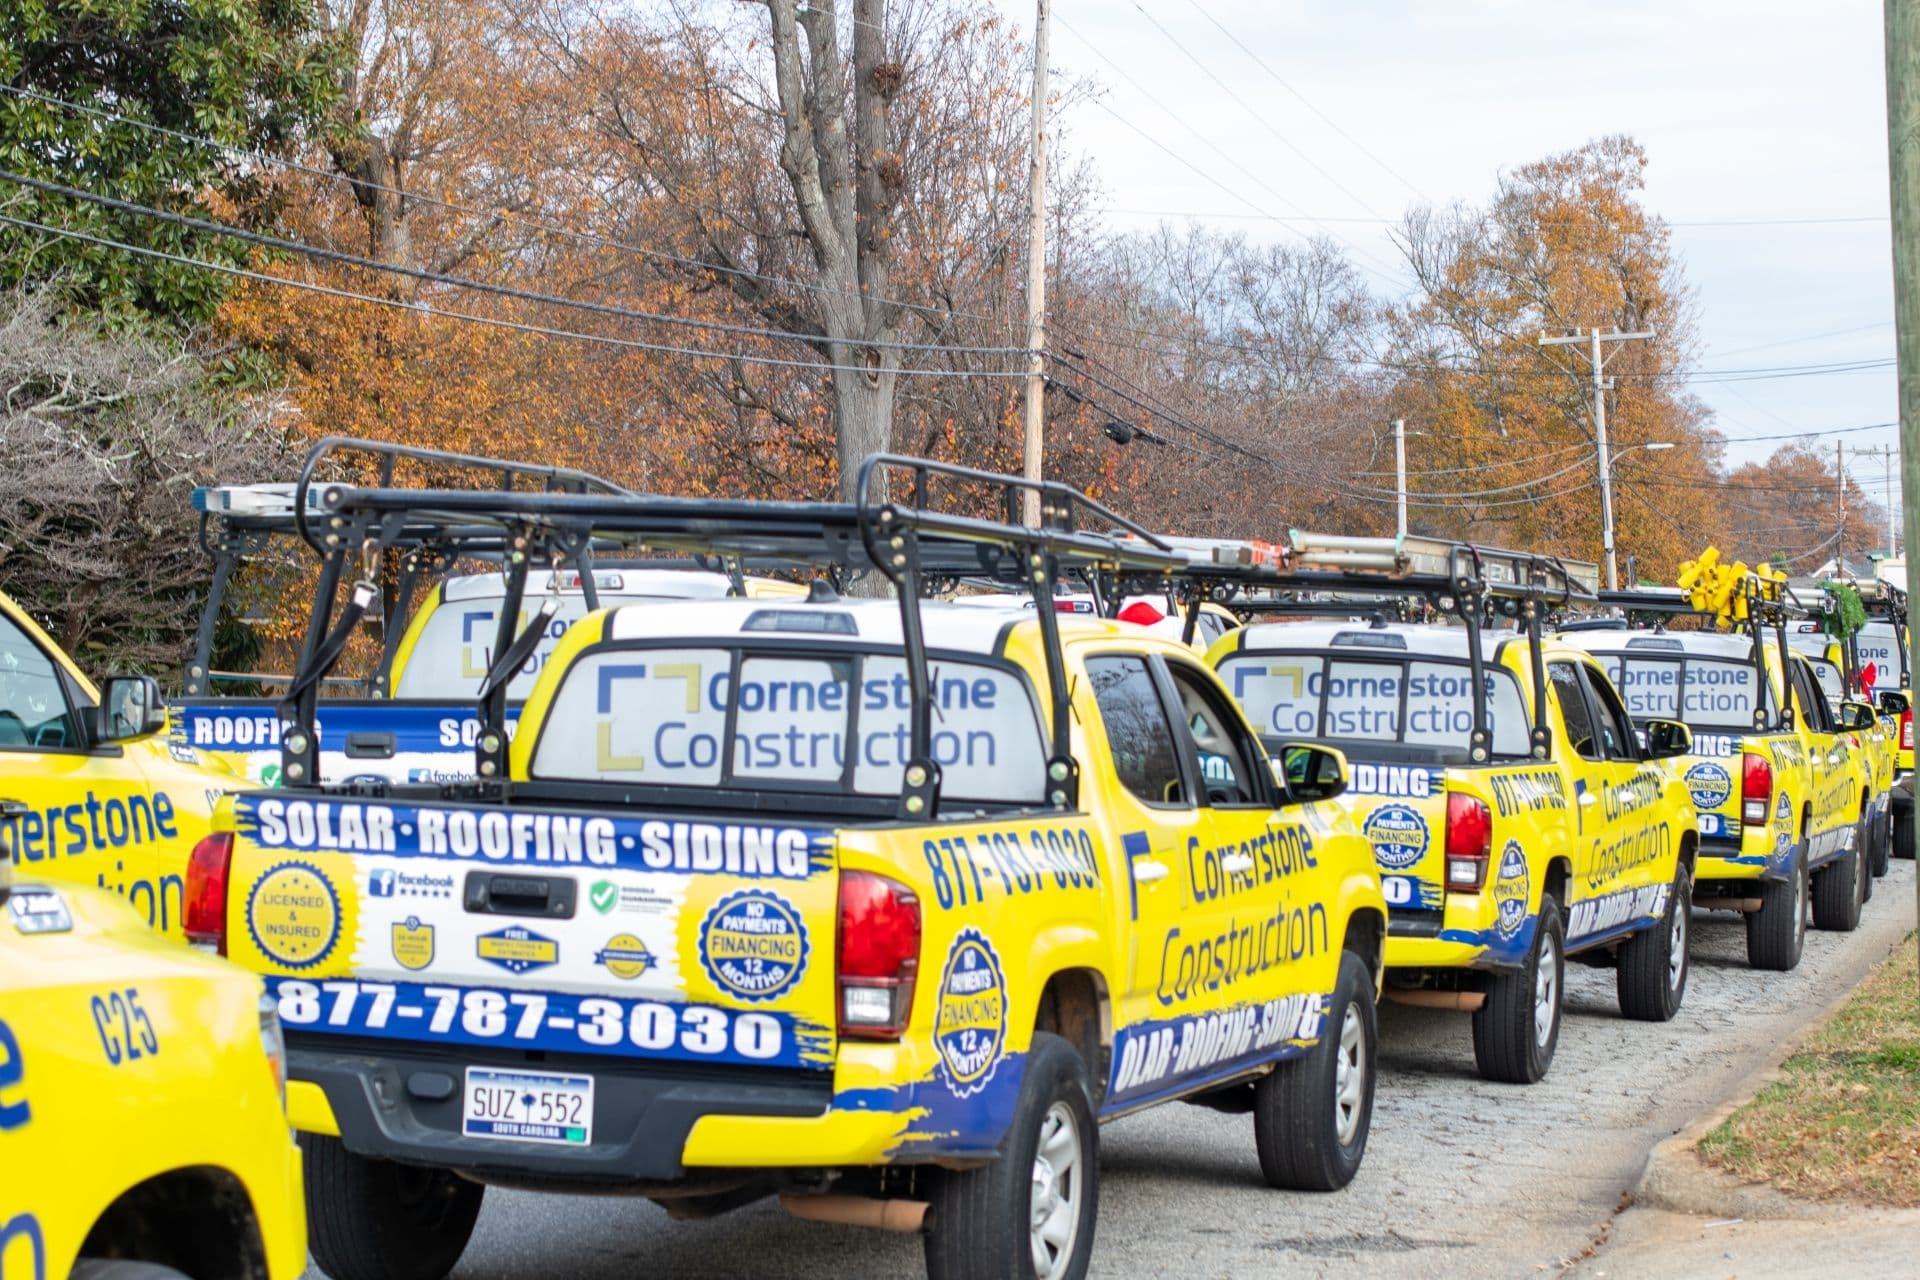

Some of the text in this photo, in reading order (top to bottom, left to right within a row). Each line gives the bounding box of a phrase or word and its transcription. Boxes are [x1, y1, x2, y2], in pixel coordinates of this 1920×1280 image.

[1607, 667, 1748, 685] Cornerstone
[708, 671, 997, 712] Cornestne
[653, 722, 996, 769] Constructon
[1688, 734, 1732, 756] ING
[1687, 780, 1727, 792] FINANCING
[258, 800, 397, 851] SOLAR
[417, 809, 618, 865] ROOFING
[640, 820, 809, 876] SIDING
[1369, 829, 1422, 844] FINANCING
[1188, 823, 1318, 904] Cornerstone
[398, 872, 454, 888] facebook
[263, 894, 324, 908] LICENSED
[746, 902, 765, 917] NO
[288, 912, 297, 922] &
[722, 915, 787, 934] PAYMENTS
[265, 923, 321, 938] INSURED
[711, 935, 796, 958] FINANCING
[1157, 888, 1328, 1006] Construction
[720, 961, 785, 989] MONTHS
[744, 958, 763, 974] 12
[277, 980, 782, 1059] 877-787-3030
[943, 997, 999, 1026] FINANCING
[90, 988, 158, 1066] C25
[960, 1030, 977, 1051] 12
[473, 1087, 583, 1124] SUZ 552
[492, 1122, 560, 1138] SOUTH CAROLINA
